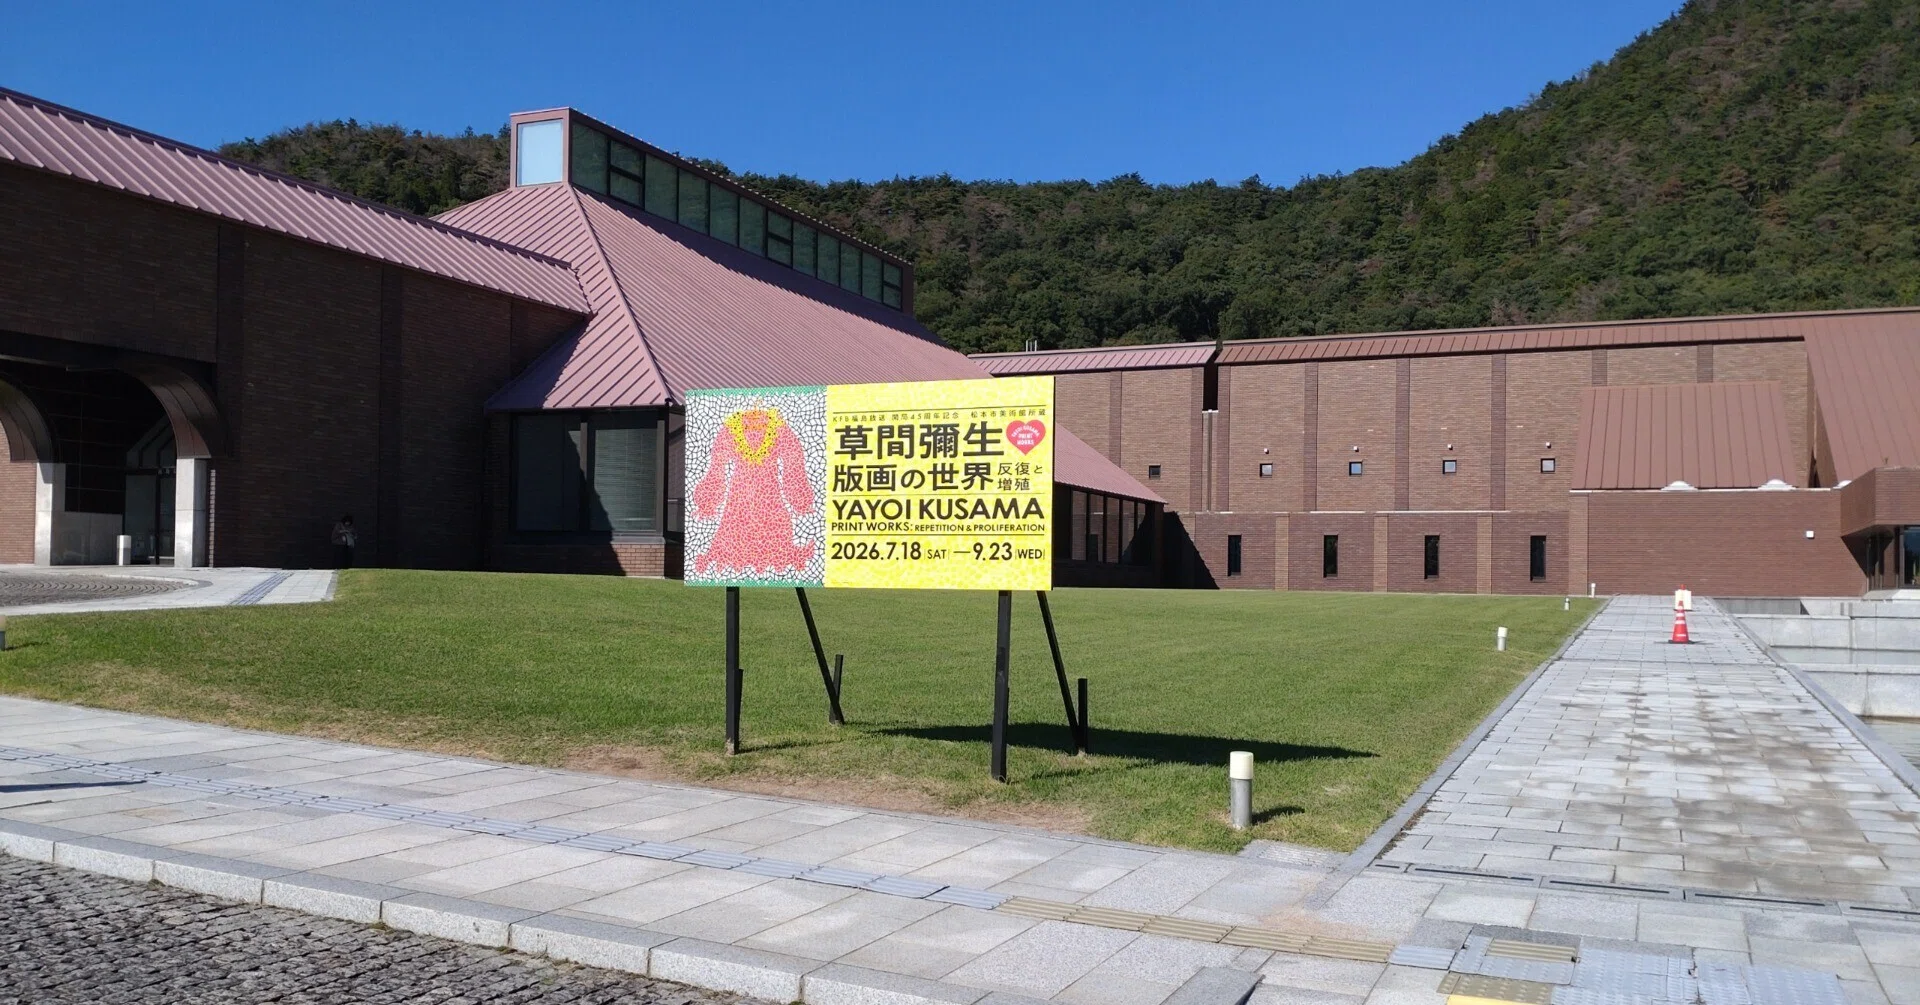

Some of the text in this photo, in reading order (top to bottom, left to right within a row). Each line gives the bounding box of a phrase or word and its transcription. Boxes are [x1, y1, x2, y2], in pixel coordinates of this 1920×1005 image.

[834, 421, 1004, 460] 草間彌生
[832, 462, 994, 492] 版画の世界
[997, 462, 1043, 476] 反復と
[997, 478, 1030, 492] 増殖
[832, 497, 1045, 520] YAYOI KUSAMA
[831, 522, 864, 532] PRINT
[866, 522, 914, 532] WORKS:
[914, 524, 964, 532] REPETITION
[973, 524, 1045, 532] PROLIFERATION
[831, 542, 922, 560] 2026.7.18
